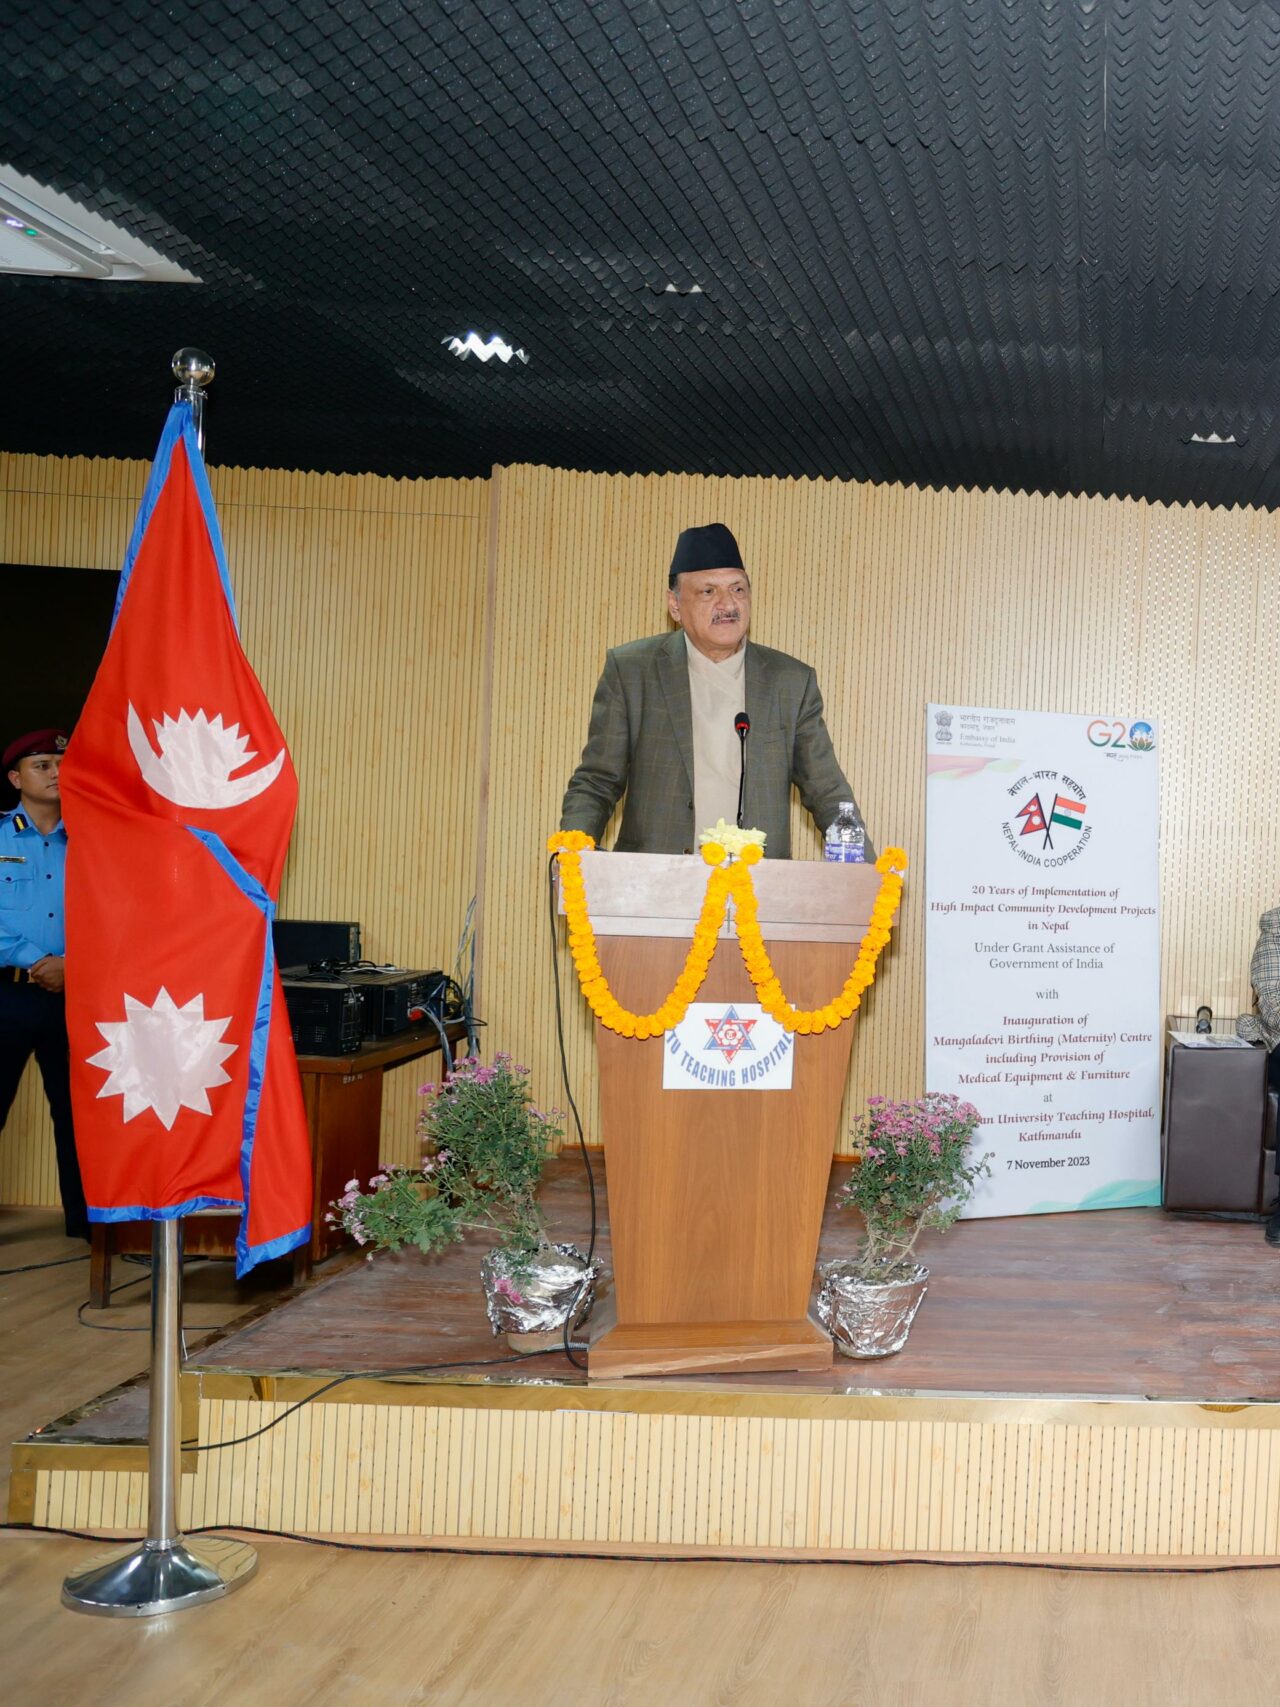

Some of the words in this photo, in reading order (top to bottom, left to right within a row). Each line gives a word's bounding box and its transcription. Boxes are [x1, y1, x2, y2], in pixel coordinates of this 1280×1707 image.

[1001, 822, 1041, 867] NEPAL-INDIA
[1043, 825, 1093, 868] COOPERATION
[972, 885, 985, 895] 20
[988, 886, 1015, 896] Years
[1018, 886, 1029, 898] of
[1031, 886, 1106, 899] Implementation
[1109, 887, 1120, 899] of
[931, 902, 957, 914] High
[960, 903, 994, 914] Impact
[997, 903, 1055, 916] Community
[1058, 904, 1117, 917] Development
[1120, 905, 1156, 918] Projects
[1028, 921, 1038, 930] in
[1041, 921, 1070, 933] Nepal
[974, 942, 1010, 953] Under
[1012, 942, 1044, 953] Grant
[1047, 943, 1101, 954] Assistance
[1103, 942, 1115, 954] of
[989, 958, 1059, 969] Government
[1062, 958, 1074, 969] of
[1076, 958, 1104, 969] India
[1036, 989, 1059, 1000] with
[1002, 1015, 1074, 1029] Inauguration
[1077, 1014, 1090, 1027] of
[933, 1034, 1004, 1049] Mangaladevi
[1007, 1033, 1054, 1046] Birthing
[1057, 1033, 1117, 1046] (Maternity)
[1120, 1033, 1152, 1043] Centre
[666, 1029, 681, 1055] TU
[680, 1051, 736, 1087] TEACHING
[741, 1033, 793, 1085] HOSPITAL
[986, 1053, 1037, 1066] including
[1040, 1052, 1091, 1062] Provision
[1094, 1050, 1106, 1063] of
[958, 1072, 1001, 1084] Medical
[1004, 1072, 1063, 1086] Equipment
[1066, 1071, 1076, 1080] &
[1080, 1070, 1130, 1080] Furniture
[1043, 1093, 1053, 1102] at
[998, 1112, 1054, 1125] University
[1056, 1110, 1105, 1123] Teaching
[1108, 1107, 1155, 1120] Hospital,
[1018, 1129, 1082, 1142] Kathmandu
[1007, 1160, 1013, 1170] 7
[1014, 1157, 1066, 1170] November
[1067, 1156, 1090, 1167] 2023
